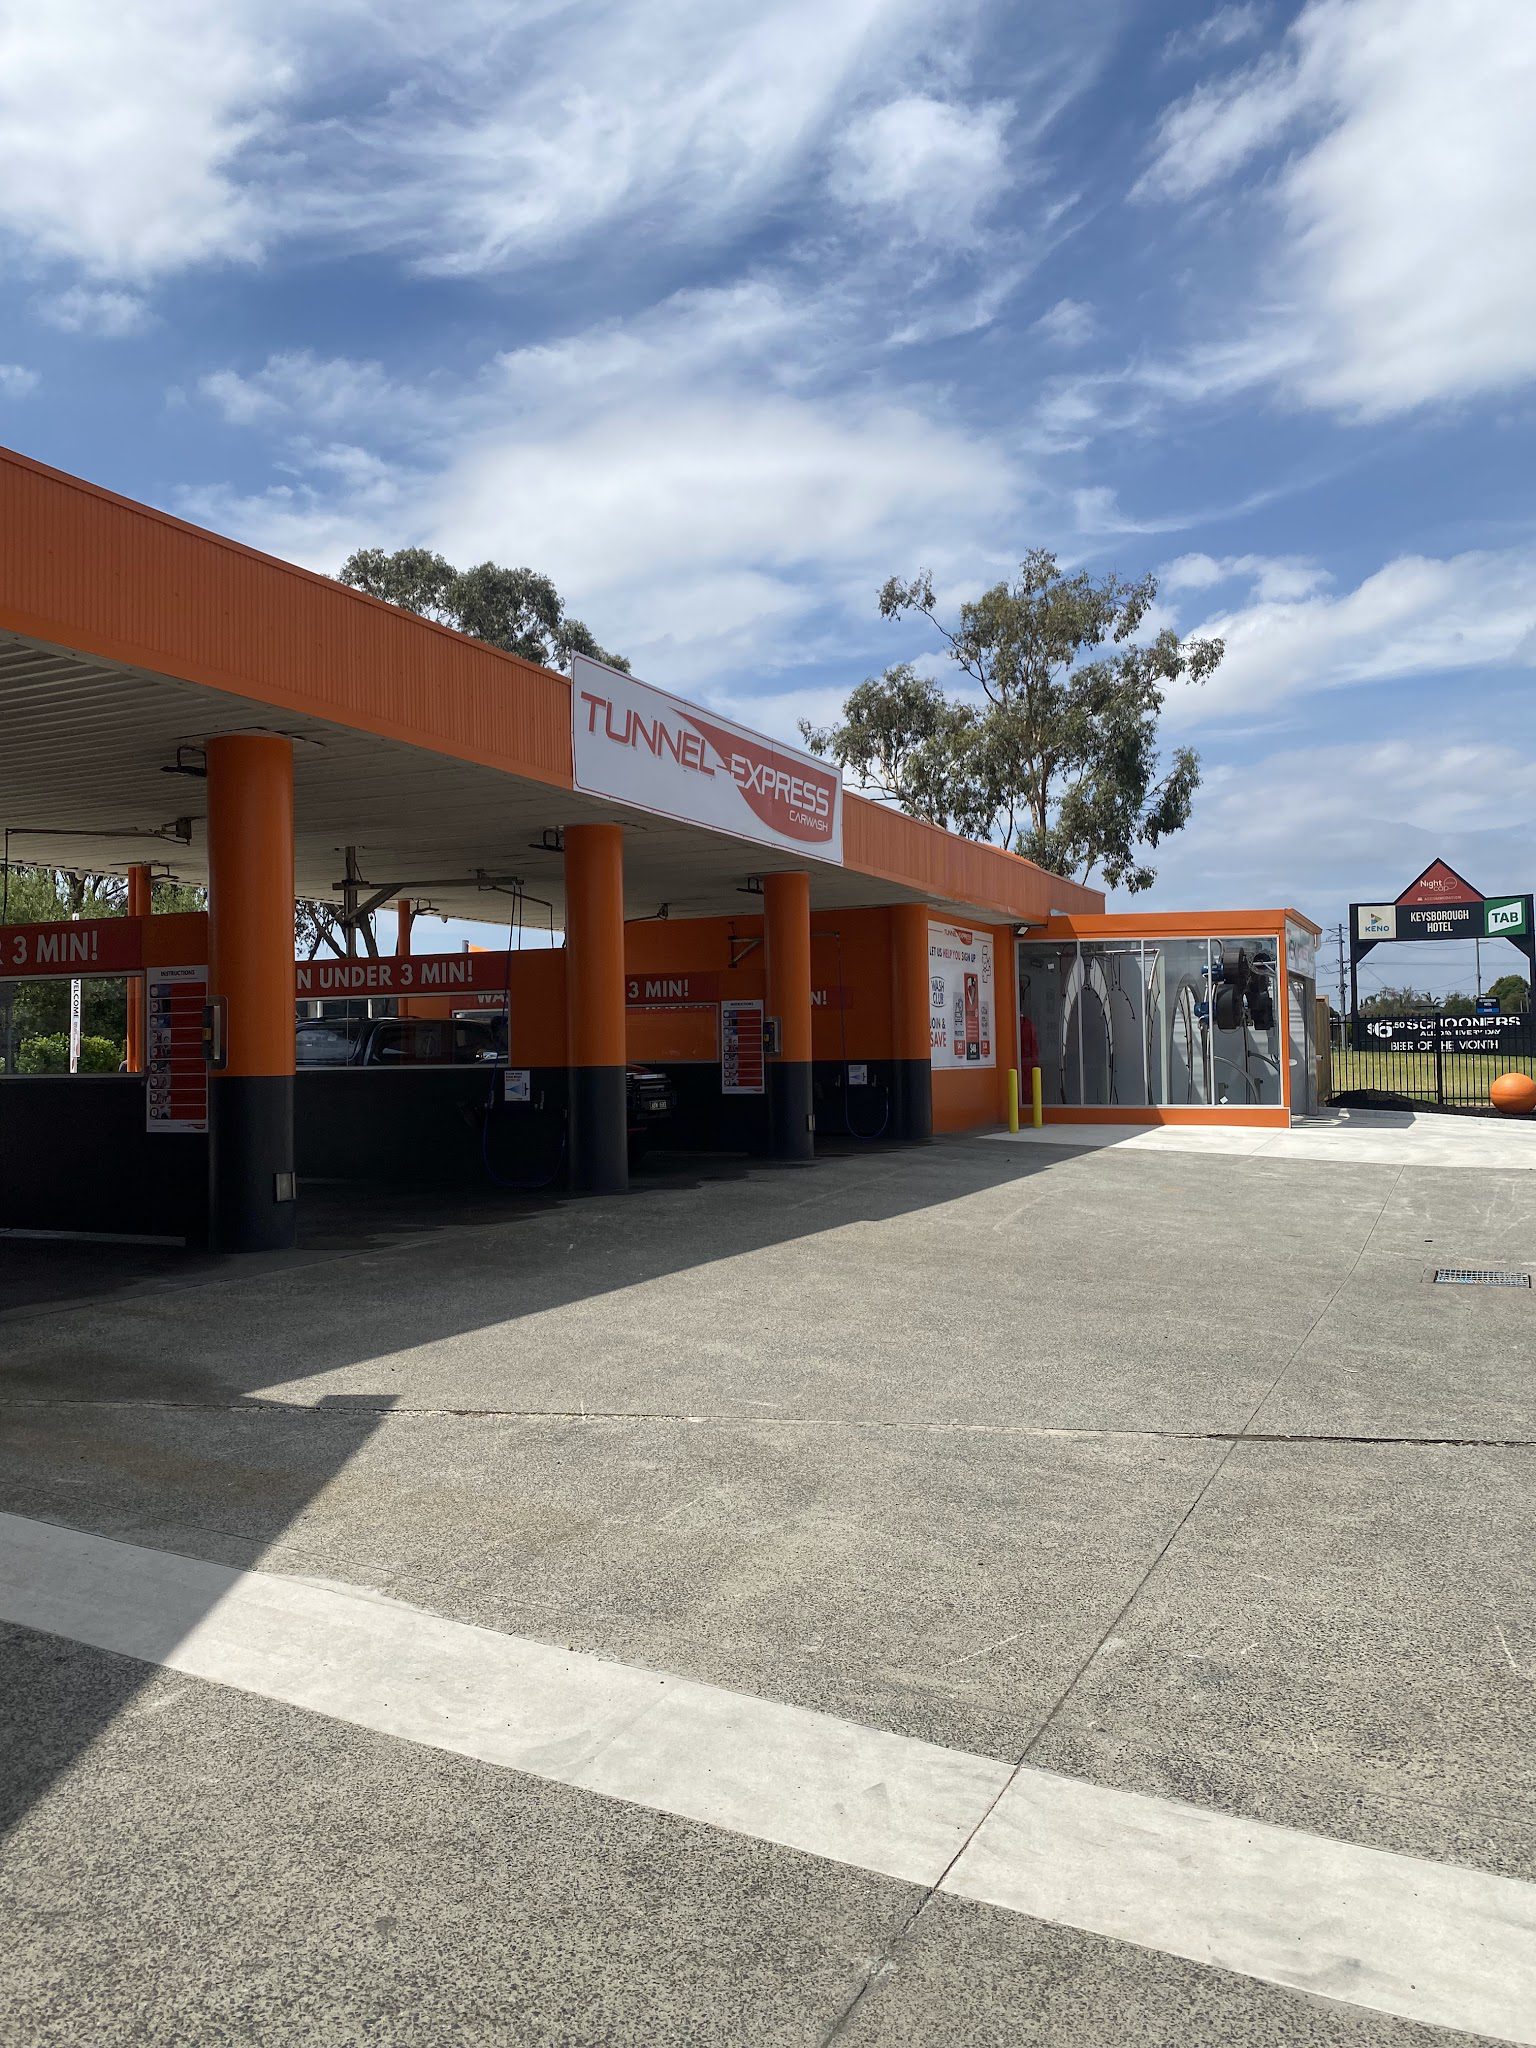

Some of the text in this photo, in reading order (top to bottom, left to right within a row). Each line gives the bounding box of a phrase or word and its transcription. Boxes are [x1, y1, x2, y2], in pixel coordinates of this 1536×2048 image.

[581, 691, 829, 817] TUNNEL EXPRESS
[789, 810, 828, 832] CARWASH
[1420, 880, 1442, 889] Night
[1410, 910, 1469, 922] KEYSBOROUGH
[1491, 911, 1519, 923] TAB
[1427, 921, 1453, 932] HOTEL
[12, 935, 28, 964] 3
[36, 930, 98, 963] MIN!
[937, 948, 942, 957] US
[943, 948, 952, 959] HELP
[952, 950, 961, 960] YOU
[961, 952, 970, 961] SIGN
[971, 954, 976, 963] UP
[160, 969, 195, 977] INSTRUCTIONS
[319, 963, 393, 989] UNDER
[400, 963, 413, 985] 3
[421, 959, 473, 984] MIN!
[628, 978, 689, 999] 3 MIN!
[931, 980, 944, 992] WASH
[932, 992, 944, 1005] CLUB
[929, 1018, 941, 1029] OIN
[929, 1031, 946, 1048] SAVE
[1390, 1041, 1414, 1051] BEER
[1418, 1040, 1433, 1050] OF
[1459, 1039, 1499, 1050] MONTH
